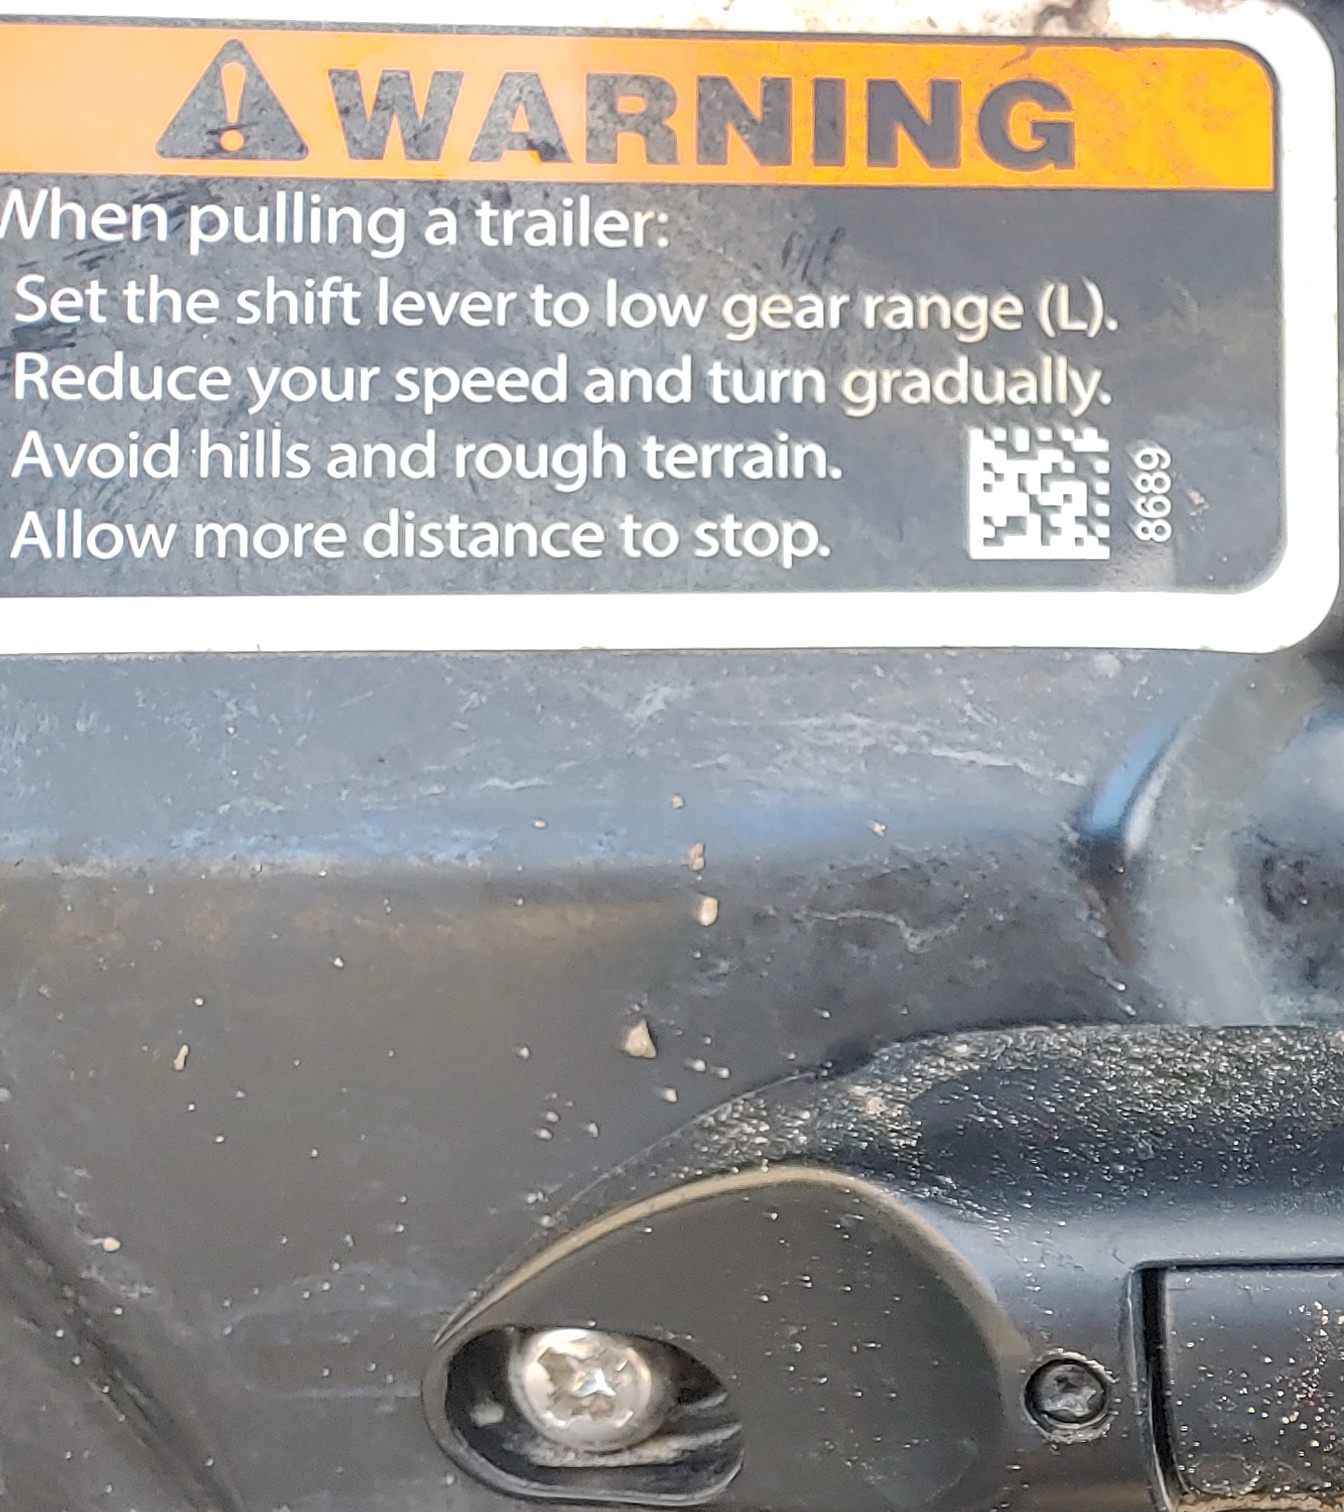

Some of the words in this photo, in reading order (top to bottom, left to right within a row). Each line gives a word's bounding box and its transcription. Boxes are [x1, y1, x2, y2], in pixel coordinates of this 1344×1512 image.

[328, 69, 1076, 171] WARNING
[0, 189, 167, 241] When
[189, 191, 405, 258] pulling
[425, 208, 458, 245] a
[475, 195, 670, 249] trailer:
[14, 274, 107, 324] Set
[123, 275, 220, 325] the
[236, 276, 361, 326] shift
[378, 277, 517, 328] lever
[531, 284, 589, 329] to
[606, 279, 708, 329] low
[722, 293, 849, 340] gear
[864, 293, 1025, 343] range
[1038, 281, 1119, 338] (L).
[14, 351, 231, 401] Reduce
[247, 364, 380, 414] your
[394, 354, 568, 414] speed
[583, 354, 692, 404] and
[709, 365, 827, 405] turn
[842, 356, 1112, 418] gradually.
[11, 429, 180, 479] Avoid
[198, 422, 311, 479] hills
[326, 429, 436, 479] and
[455, 429, 627, 492] rough
[642, 433, 842, 481] terrain.
[1134, 446, 1173, 543] 8689
[10, 508, 176, 559] Allow
[195, 519, 347, 559] more
[362, 509, 605, 559] distance
[619, 514, 679, 559] to
[694, 516, 831, 569] stop.
